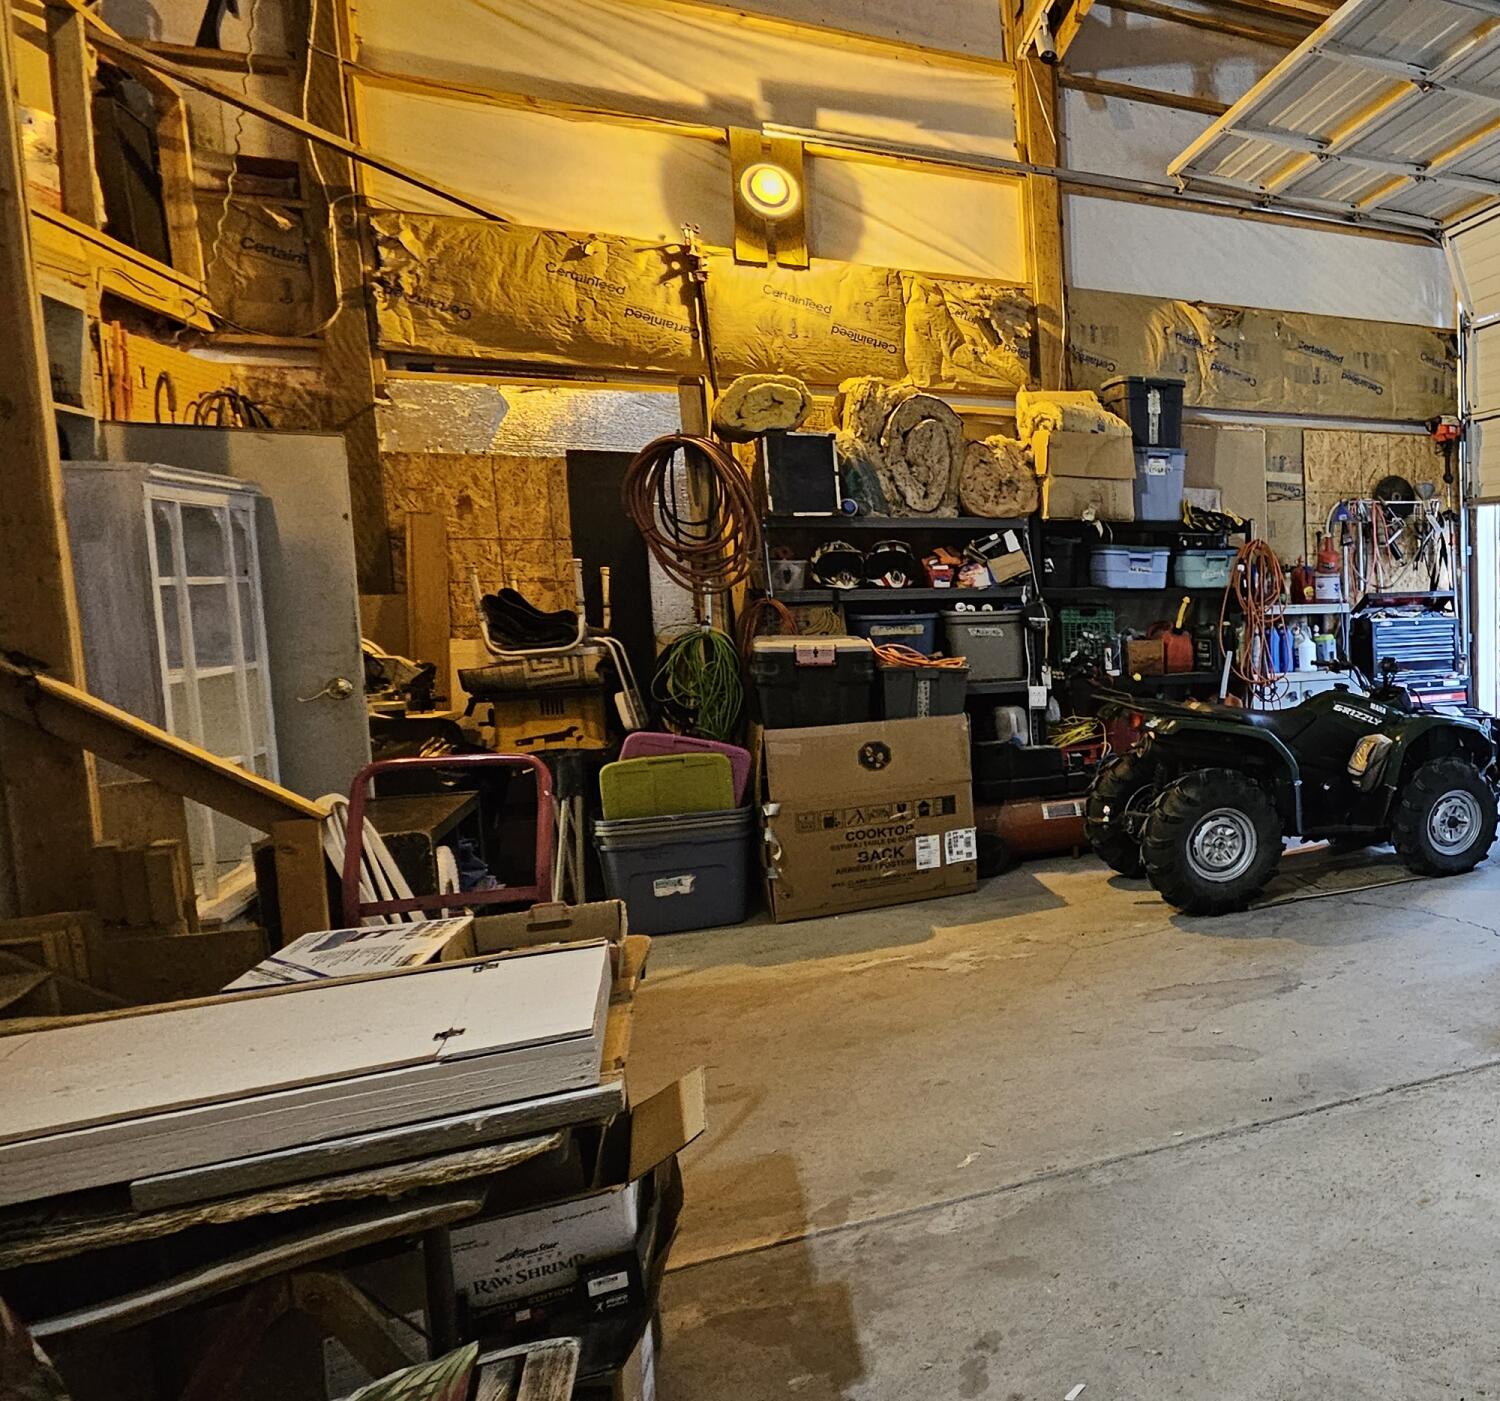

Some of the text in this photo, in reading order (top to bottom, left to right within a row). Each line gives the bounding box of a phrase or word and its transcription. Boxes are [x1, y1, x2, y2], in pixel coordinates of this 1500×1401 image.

[240, 236, 309, 265] Certain
[545, 261, 626, 297] CertainTeed
[762, 284, 832, 315] CertainTeed
[624, 306, 700, 340] CertainTeed
[830, 324, 898, 355] CertainTeed
[1333, 704, 1383, 725] GRIZZLY
[845, 823, 915, 842] COOKTOP
